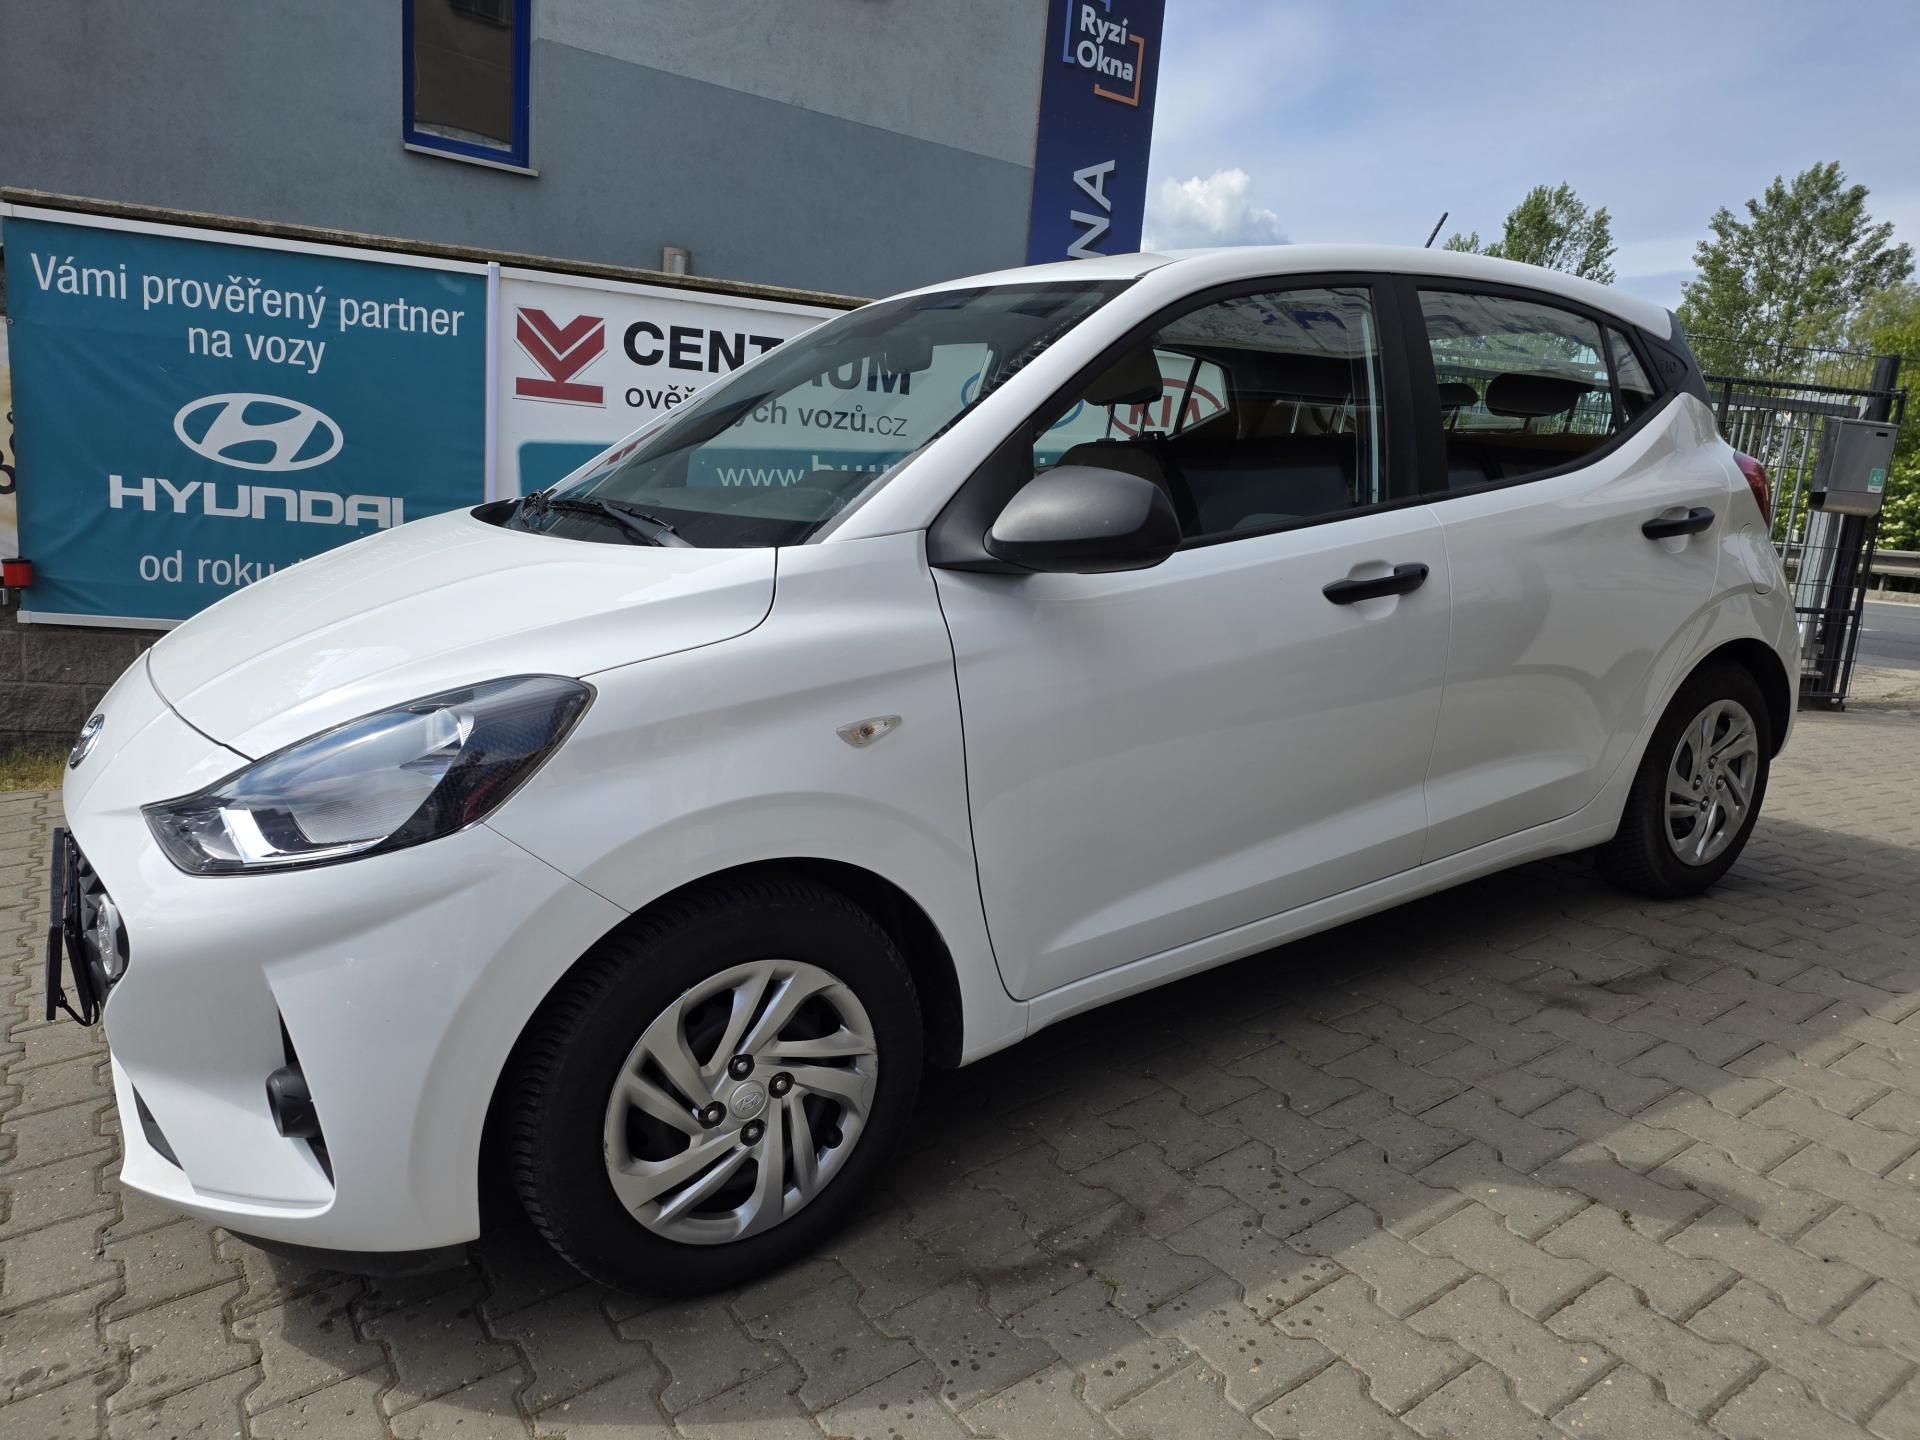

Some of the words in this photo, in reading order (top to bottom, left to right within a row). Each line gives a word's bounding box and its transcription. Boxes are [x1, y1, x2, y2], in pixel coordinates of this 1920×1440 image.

[1080, 4, 1129, 45] Ryzí
[1076, 40, 1134, 82] Okna
[31, 252, 127, 300] Vámi
[143, 275, 326, 328] prověřený
[339, 297, 465, 336] partner
[188, 325, 233, 359] na
[245, 332, 327, 374] vozy
[798, 404, 908, 437] vozů.cz
[109, 474, 404, 529] HYUNDAI
[139, 549, 183, 583] od
